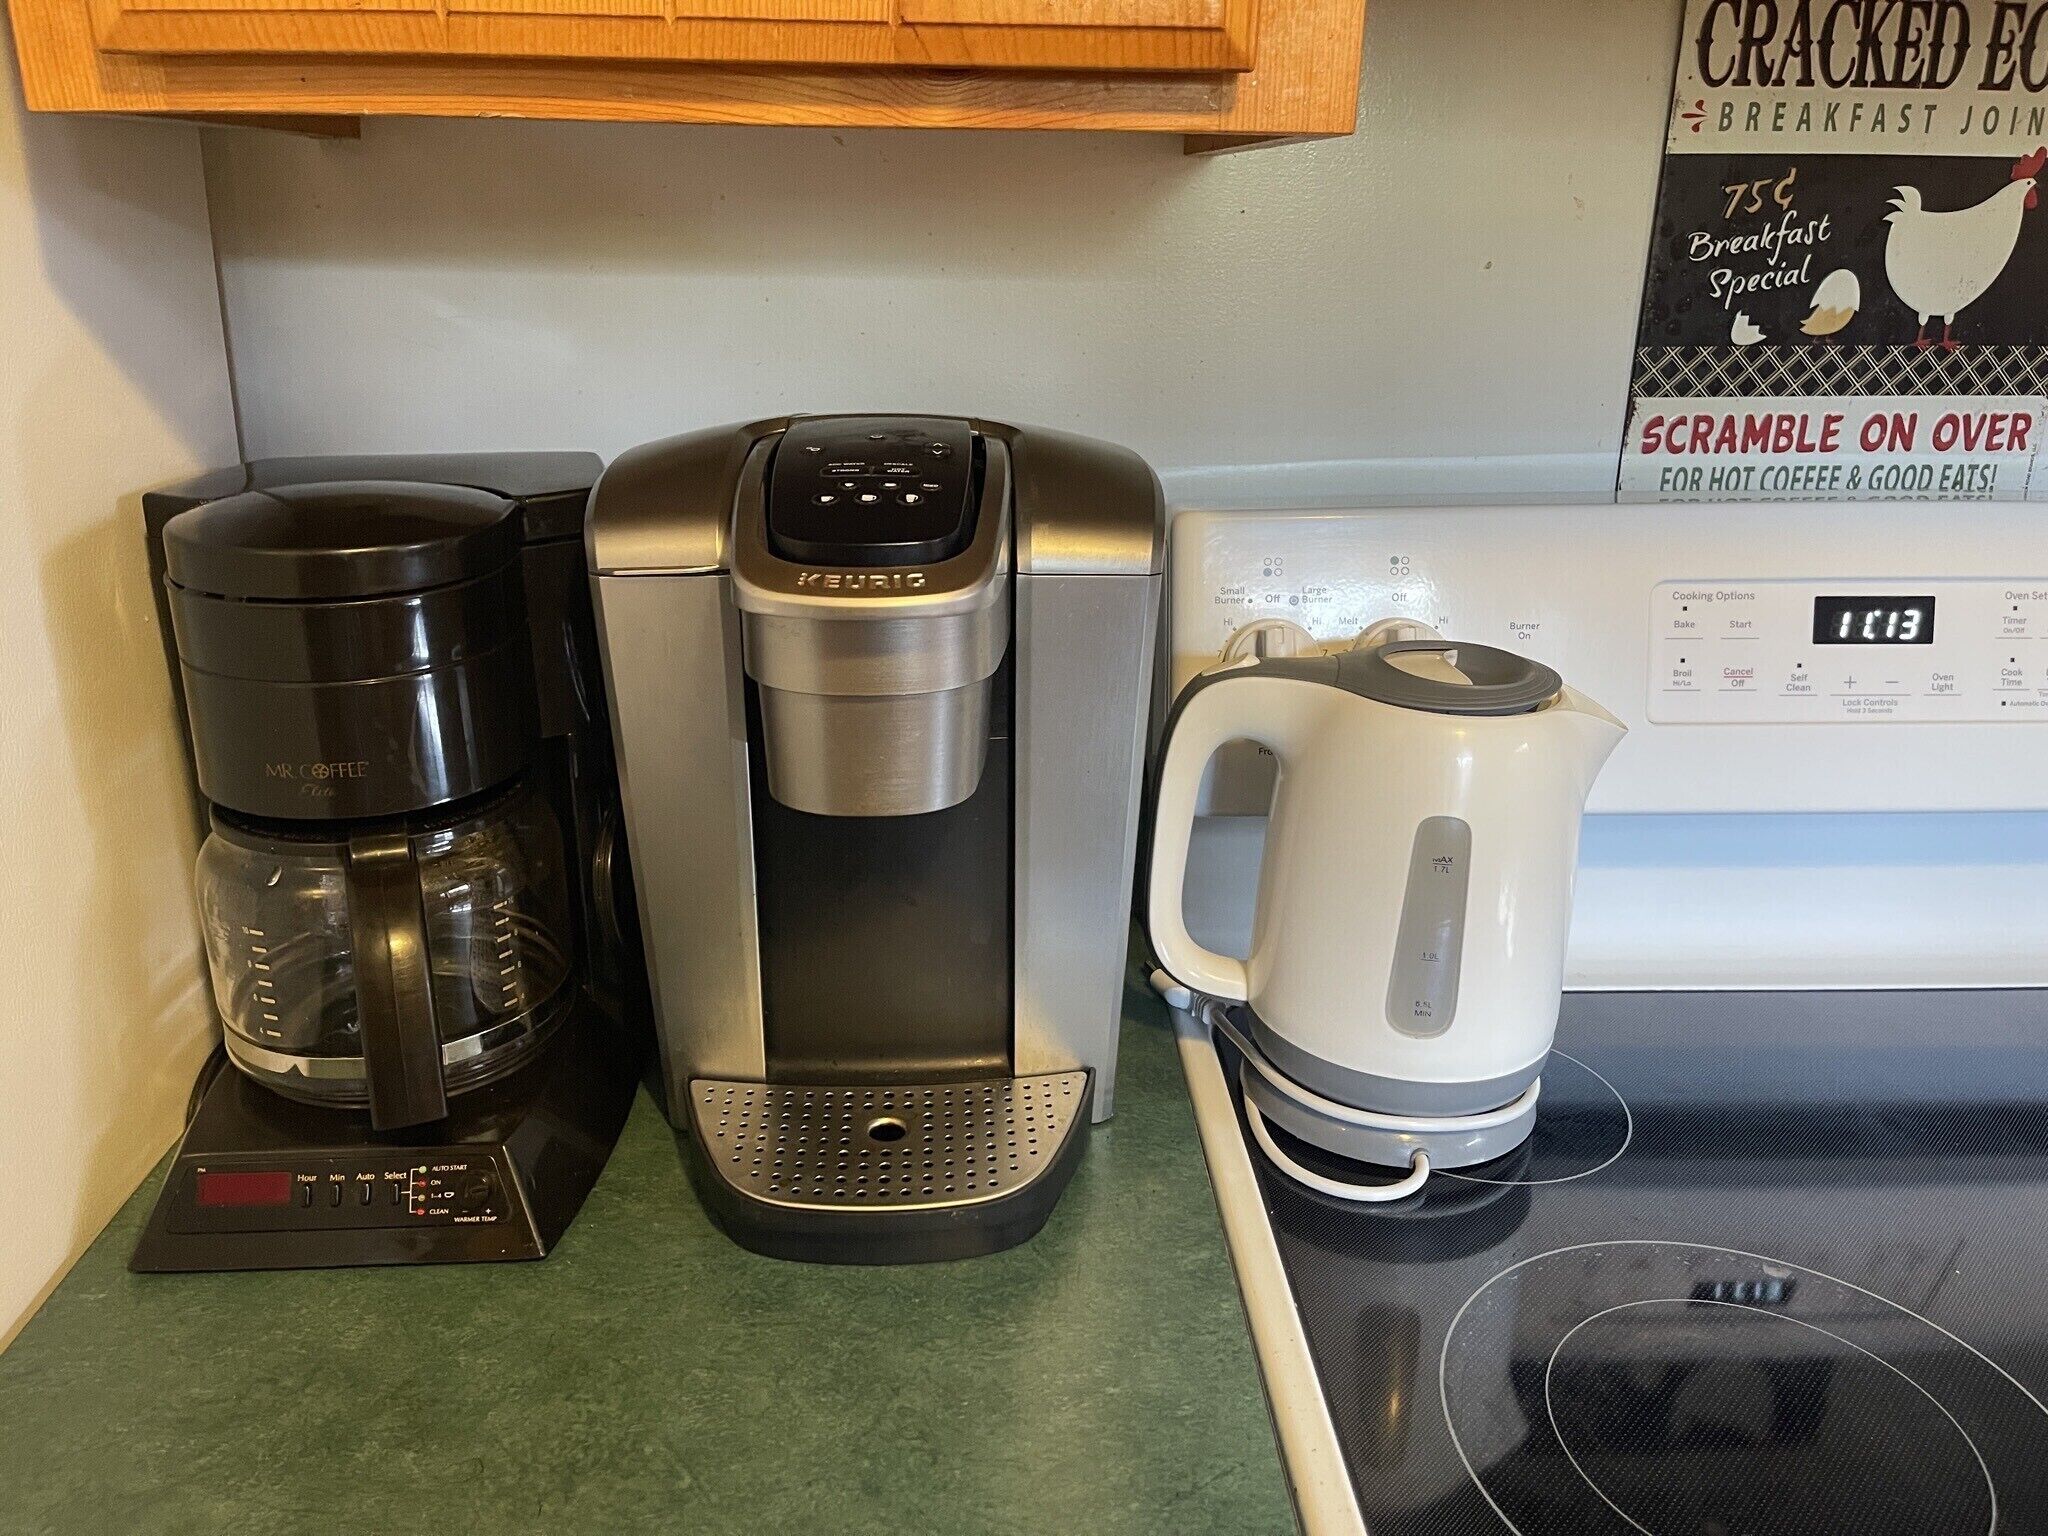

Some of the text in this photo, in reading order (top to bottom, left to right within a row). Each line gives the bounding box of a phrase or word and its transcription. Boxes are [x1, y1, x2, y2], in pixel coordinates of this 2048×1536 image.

[1695, 0, 1971, 88] CRACKED
[1718, 102, 1937, 134] BREAKFAST
[1724, 167, 1797, 219] 75¢
[1688, 210, 1831, 266] Breakfast
[1709, 254, 1812, 310] Special
[1640, 412, 2032, 454] SCRAMBLE ON OVER
[1659, 466, 1703, 491] FOR
[1709, 466, 1755, 491] HOT
[1760, 465, 1842, 491] COFFEE
[1846, 464, 1861, 490] &
[1868, 464, 1933, 490] GOOD
[1938, 463, 1998, 493] EATS!
[797, 572, 926, 590] KEURIG
[1220, 587, 1245, 596] Small
[1302, 586, 1327, 596] Large
[2005, 590, 2029, 600] Oven
[1214, 596, 1245, 604] Burner
[1265, 593, 1281, 604] Off
[1391, 592, 1407, 602] Off
[1672, 591, 1755, 602] Cooking Options
[1223, 618, 1233, 626] Hi
[1438, 617, 1449, 625] Hi
[1674, 620, 1696, 629] Bake
[1729, 620, 1752, 629] Start
[2002, 616, 2027, 624] Timer
[1509, 622, 1540, 630] Burner
[1518, 631, 1531, 640] On
[1673, 669, 1692, 677] Broil
[1723, 667, 1754, 676] Cancel
[2001, 668, 2023, 676] Cook
[1790, 673, 1808, 682] Self
[1932, 673, 1954, 681] Oven
[2001, 677, 2023, 686] Time
[1731, 679, 1745, 687] Off
[1786, 683, 1811, 692] Clean
[1931, 682, 1954, 692] Light
[1863, 698, 1898, 706] Controls
[300, 761, 367, 779] COFFEE
[297, 1174, 318, 1182] Hour
[329, 1173, 346, 1182] Min
[356, 1172, 375, 1181] Auto
[384, 1171, 407, 1180] Select
